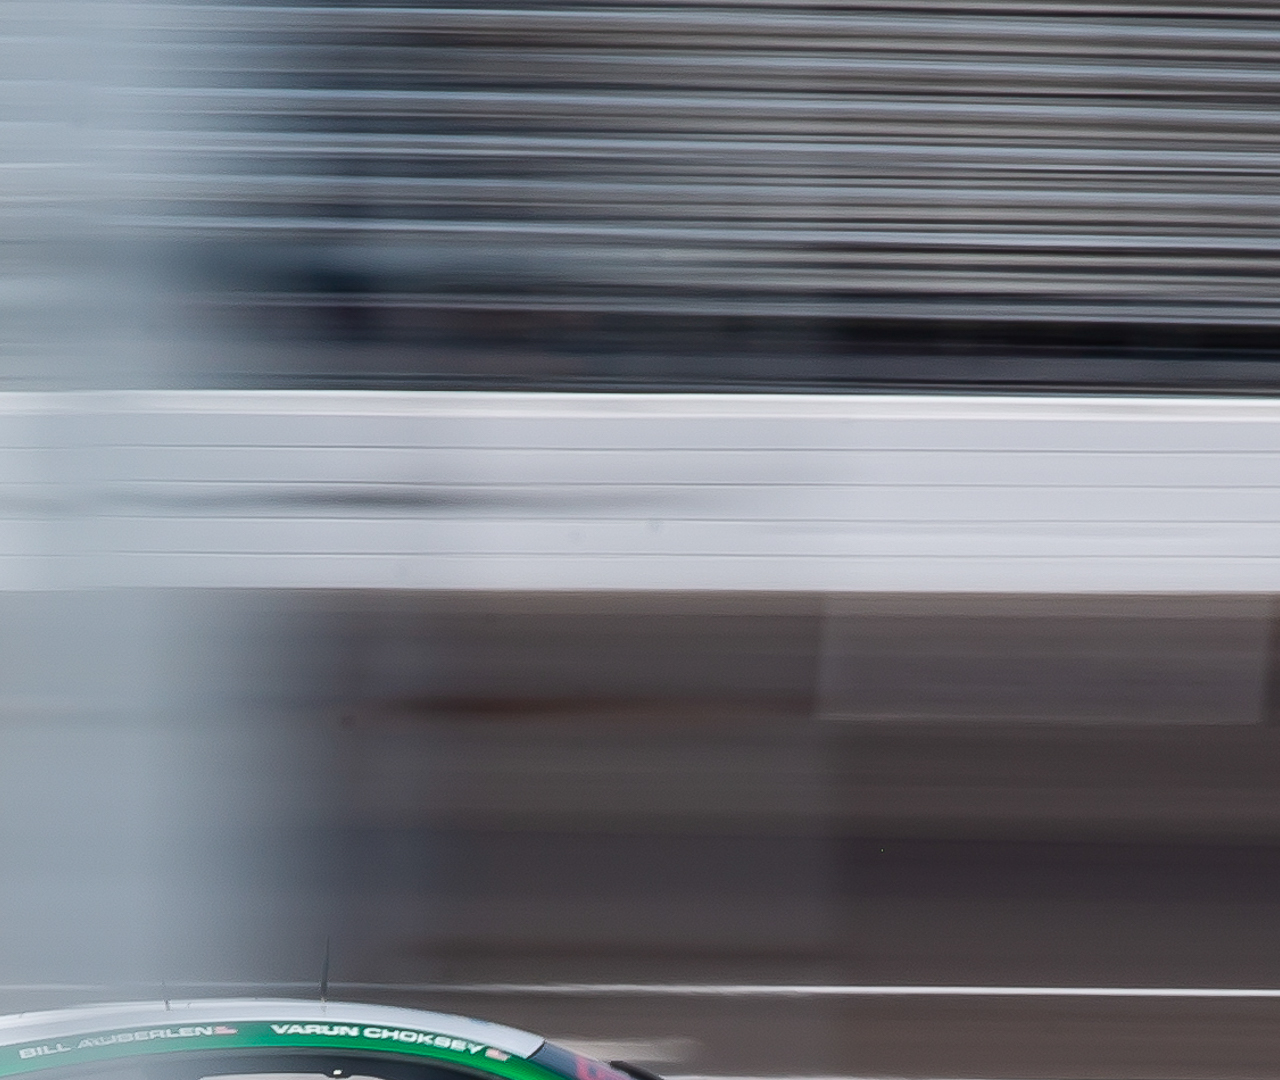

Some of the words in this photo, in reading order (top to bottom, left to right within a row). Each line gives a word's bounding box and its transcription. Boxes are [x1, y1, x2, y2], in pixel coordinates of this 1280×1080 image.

[19, 1043, 71, 1060] BILL
[77, 1025, 213, 1049] AUBERLEN
[270, 1023, 359, 1037] VARUN
[363, 1026, 485, 1056] CHOKSEY
